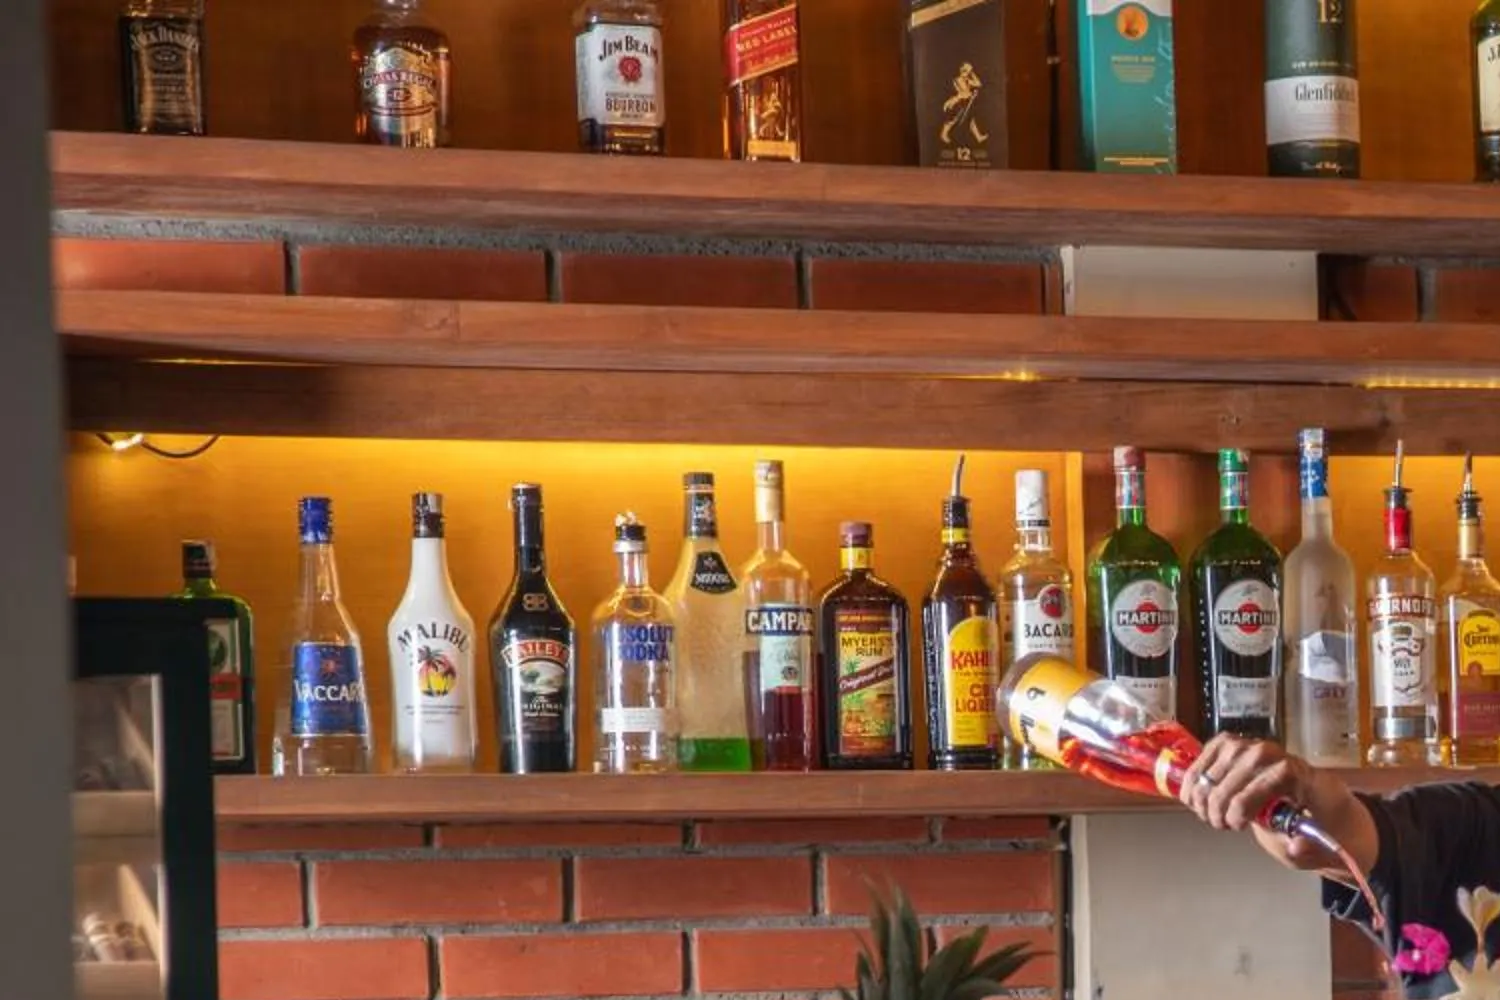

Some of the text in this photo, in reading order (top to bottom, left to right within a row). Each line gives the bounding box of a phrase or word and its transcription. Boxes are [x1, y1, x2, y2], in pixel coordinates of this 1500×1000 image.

[599, 35, 659, 64] JIM BEAM
[748, 610, 814, 633] CAMPA
[397, 621, 469, 653] MALIBU
[619, 643, 671, 662] ODKA
